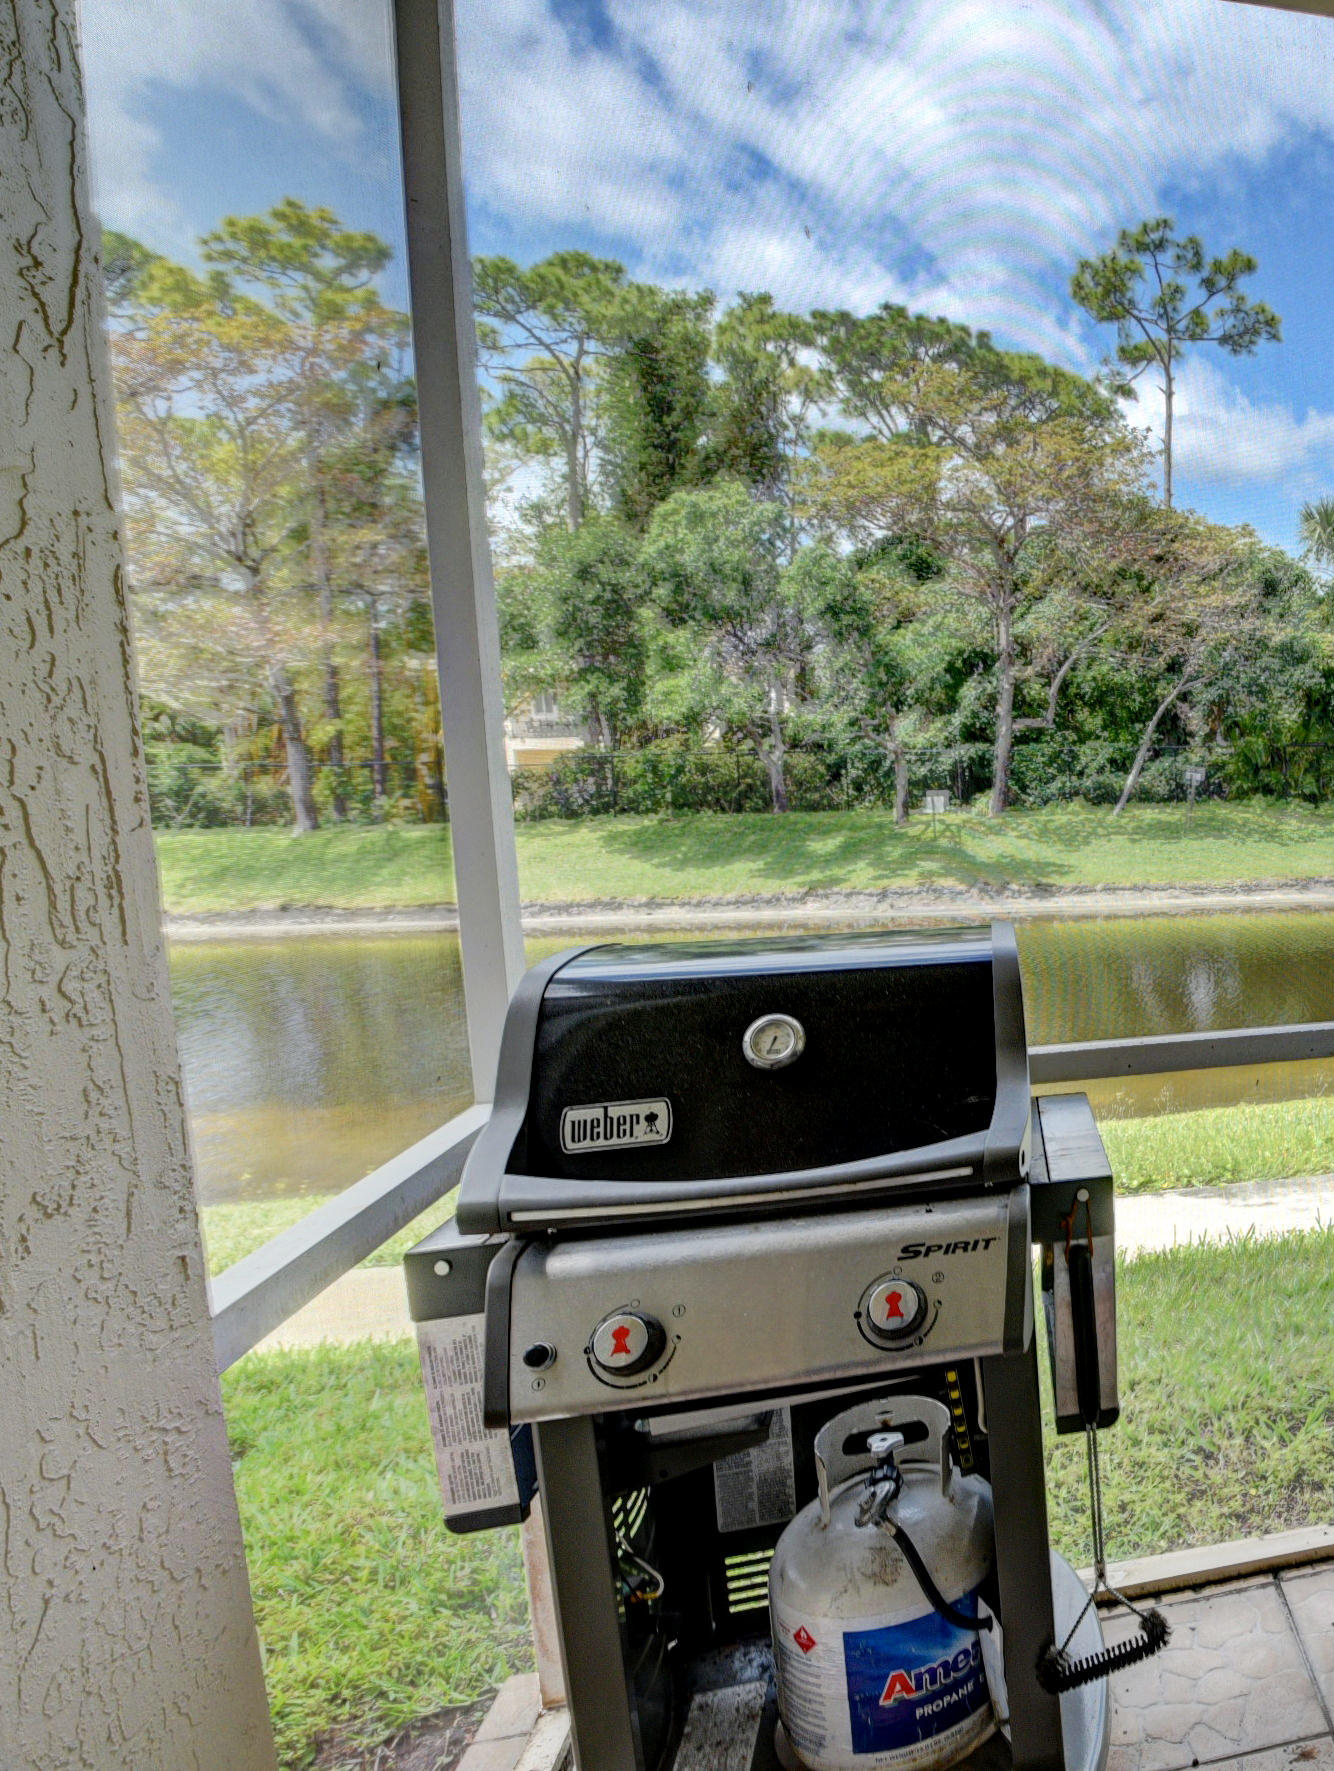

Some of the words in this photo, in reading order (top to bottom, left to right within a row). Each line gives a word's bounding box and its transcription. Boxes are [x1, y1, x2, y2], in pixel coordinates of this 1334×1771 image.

[570, 1105, 641, 1143] weber
[897, 1237, 998, 1261] SPIRIT
[915, 1678, 974, 1721] PROPANE
